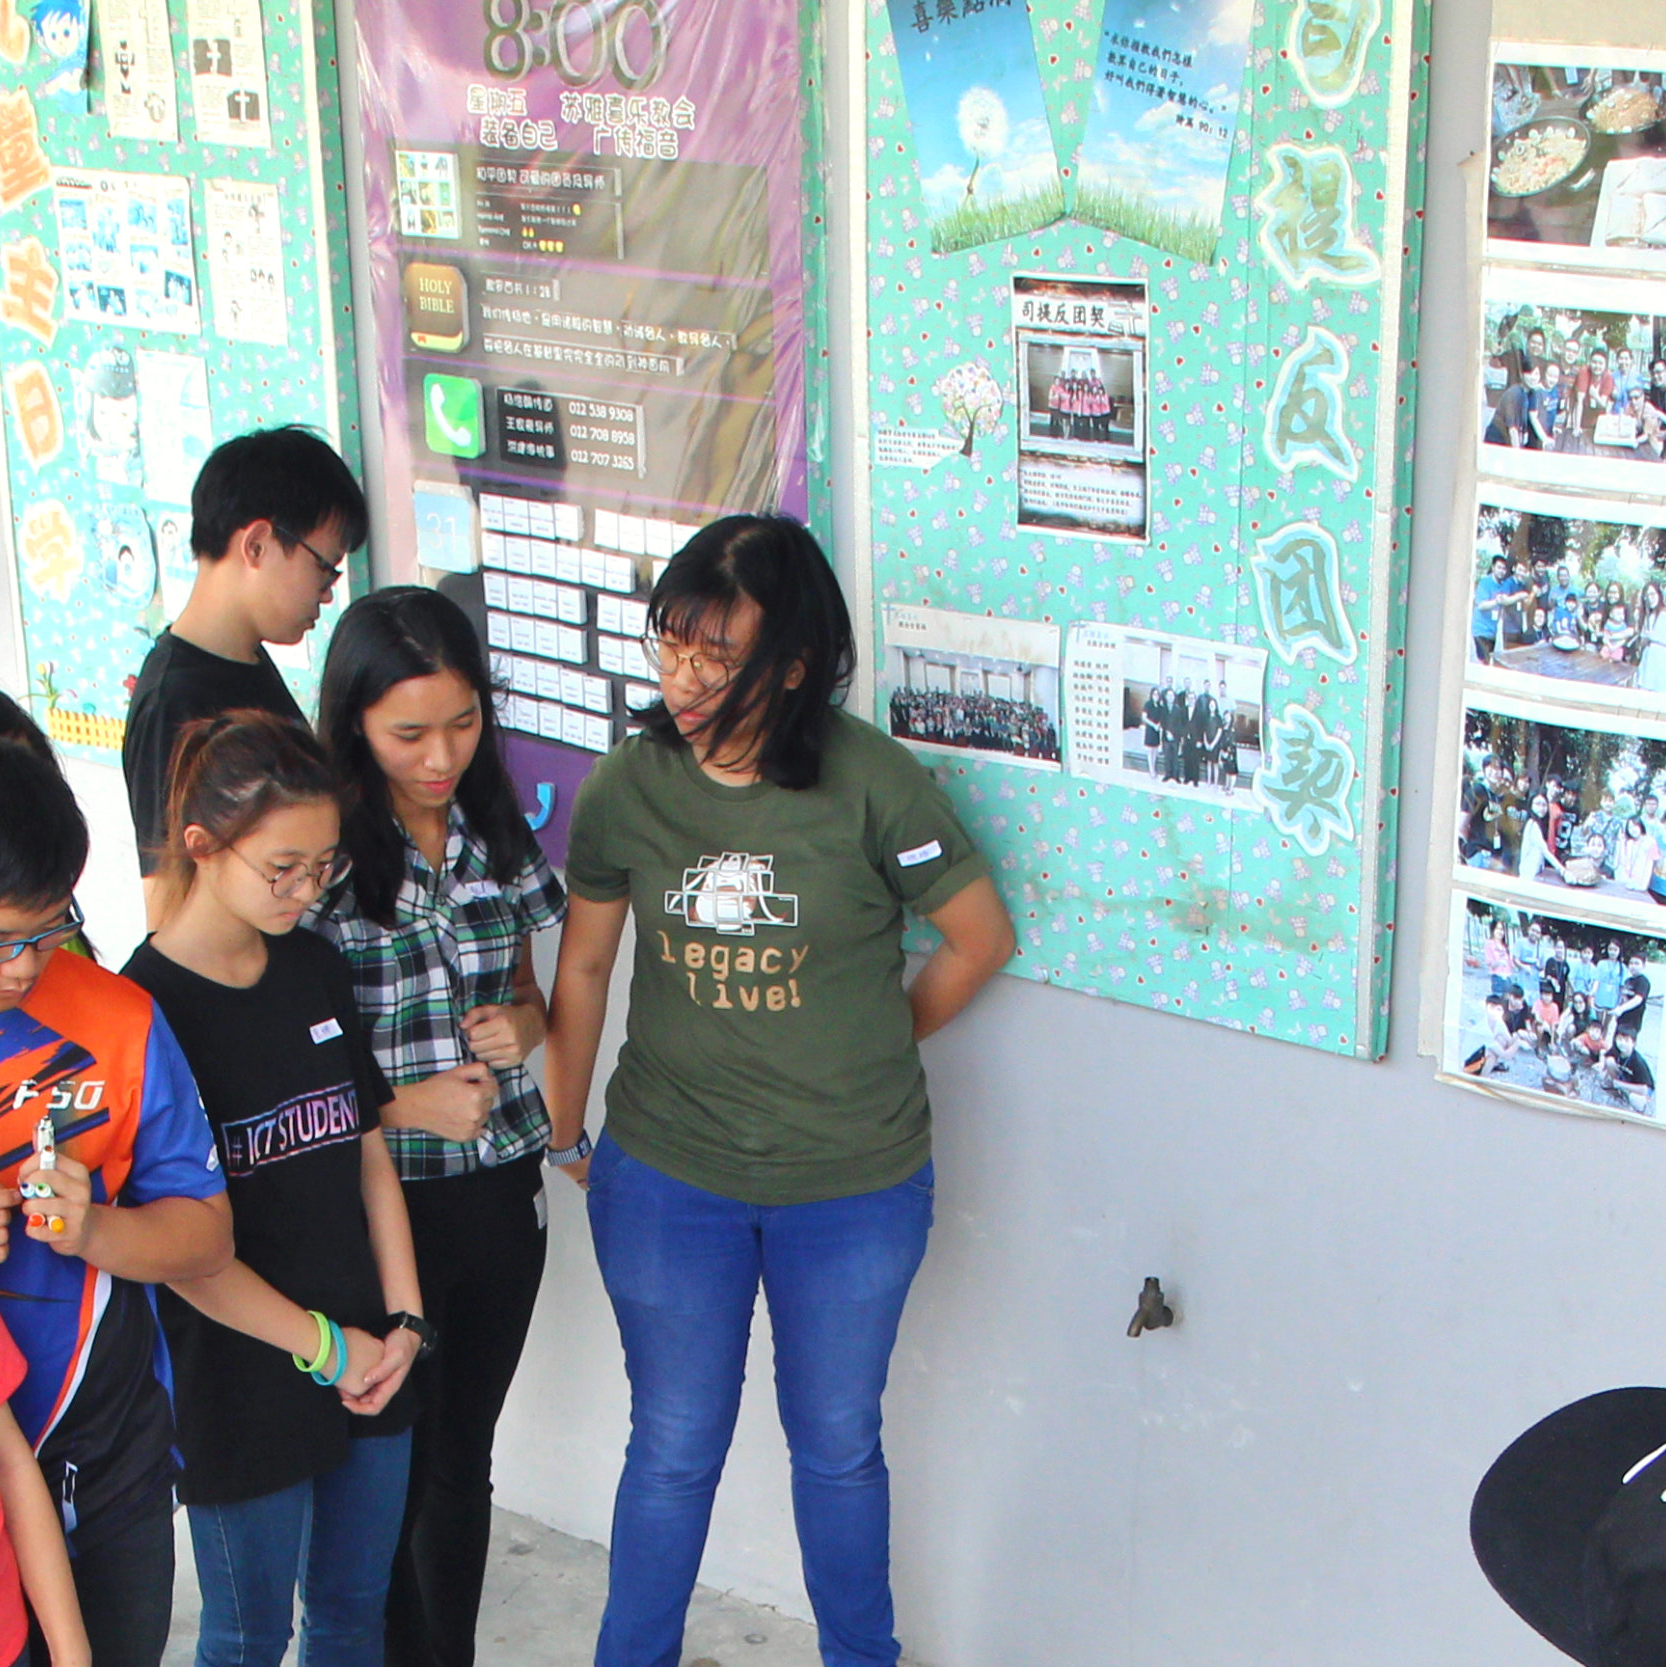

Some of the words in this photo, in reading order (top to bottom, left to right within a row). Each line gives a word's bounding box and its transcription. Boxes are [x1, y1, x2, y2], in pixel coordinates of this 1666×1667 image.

[467, 84, 527, 117] 星期五
[559, 91, 695, 130] 苏雅喜乐教会
[480, 116, 558, 151] 装备自己
[593, 125, 679, 160] 广传福音
[419, 277, 453, 295] HOLY
[419, 296, 454, 314] BIBLE
[1021, 300, 1106, 329] 司提反团契
[569, 401, 586, 416] 012
[589, 403, 606, 419] 538
[609, 407, 634, 423] 9308
[570, 425, 588, 439] 012
[589, 427, 609, 442] 708
[571, 449, 589, 463] 012
[426, 511, 459, 552] 31
[657, 930, 810, 981] legacy
[686, 971, 802, 1013] live!
